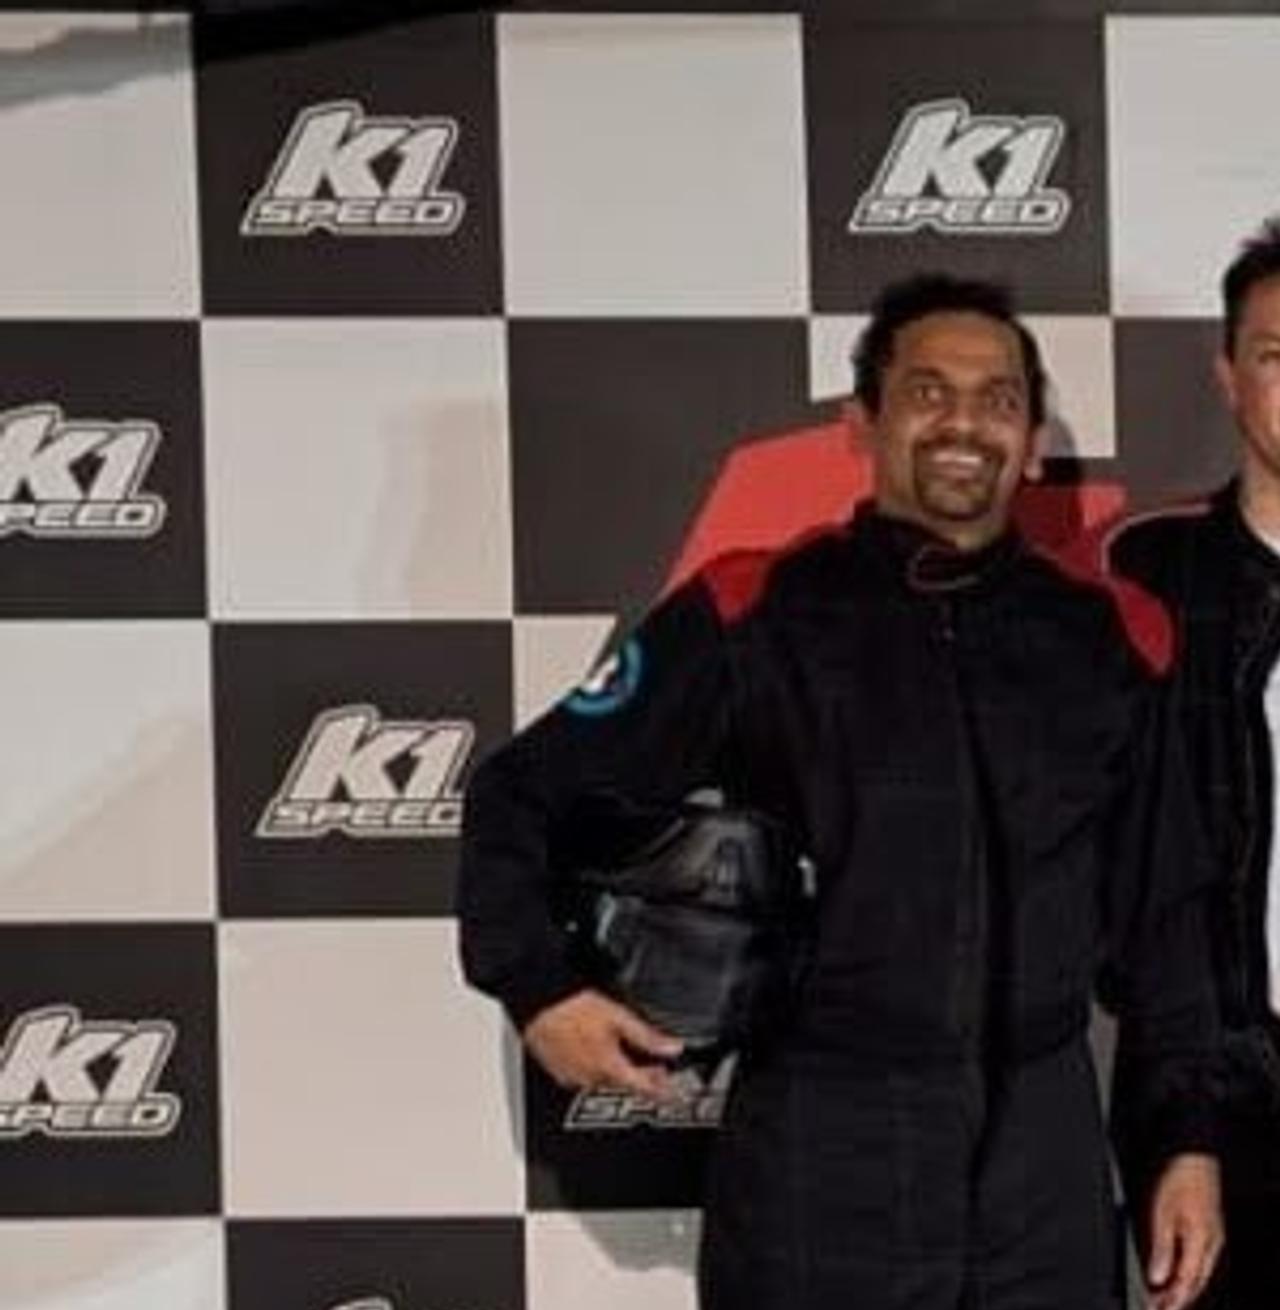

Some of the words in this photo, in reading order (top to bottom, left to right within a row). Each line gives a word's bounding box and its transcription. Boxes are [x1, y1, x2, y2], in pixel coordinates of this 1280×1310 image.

[278, 109, 450, 198] K1
[882, 110, 1051, 197] K1
[257, 201, 455, 223] SPEED
[862, 200, 1060, 222] SPEED
[0, 503, 158, 526] PEED
[290, 715, 464, 798] K1
[0, 1013, 166, 1100] K1
